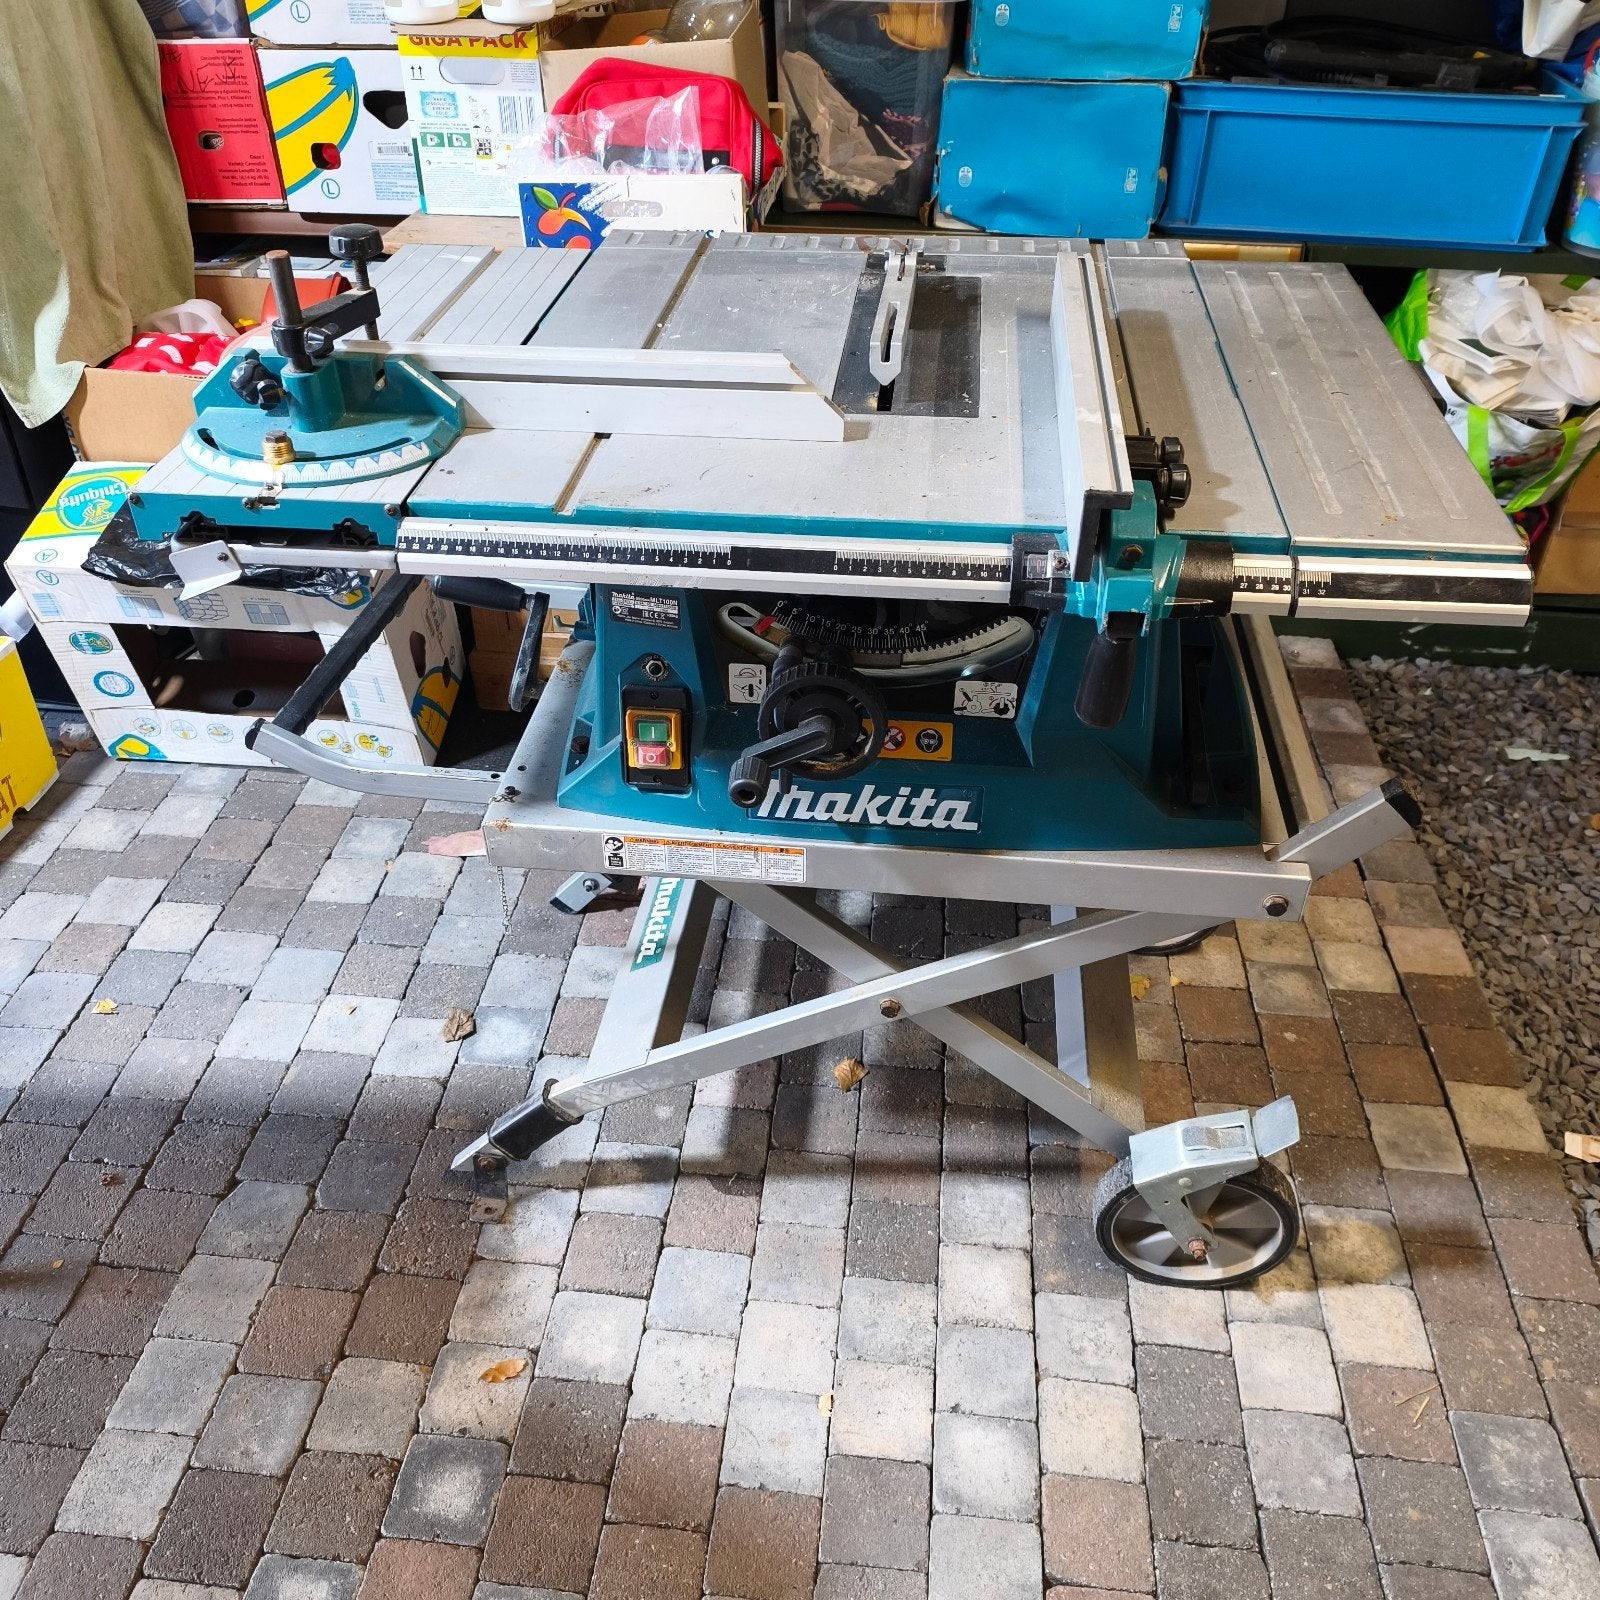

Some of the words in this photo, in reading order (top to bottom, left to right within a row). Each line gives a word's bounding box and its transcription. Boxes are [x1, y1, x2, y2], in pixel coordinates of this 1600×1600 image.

[408, 34, 463, 47] GIGA
[469, 32, 528, 49] PACK
[59, 481, 128, 510] Chiquita
[755, 778, 978, 831] makita
[635, 877, 681, 964] makita
